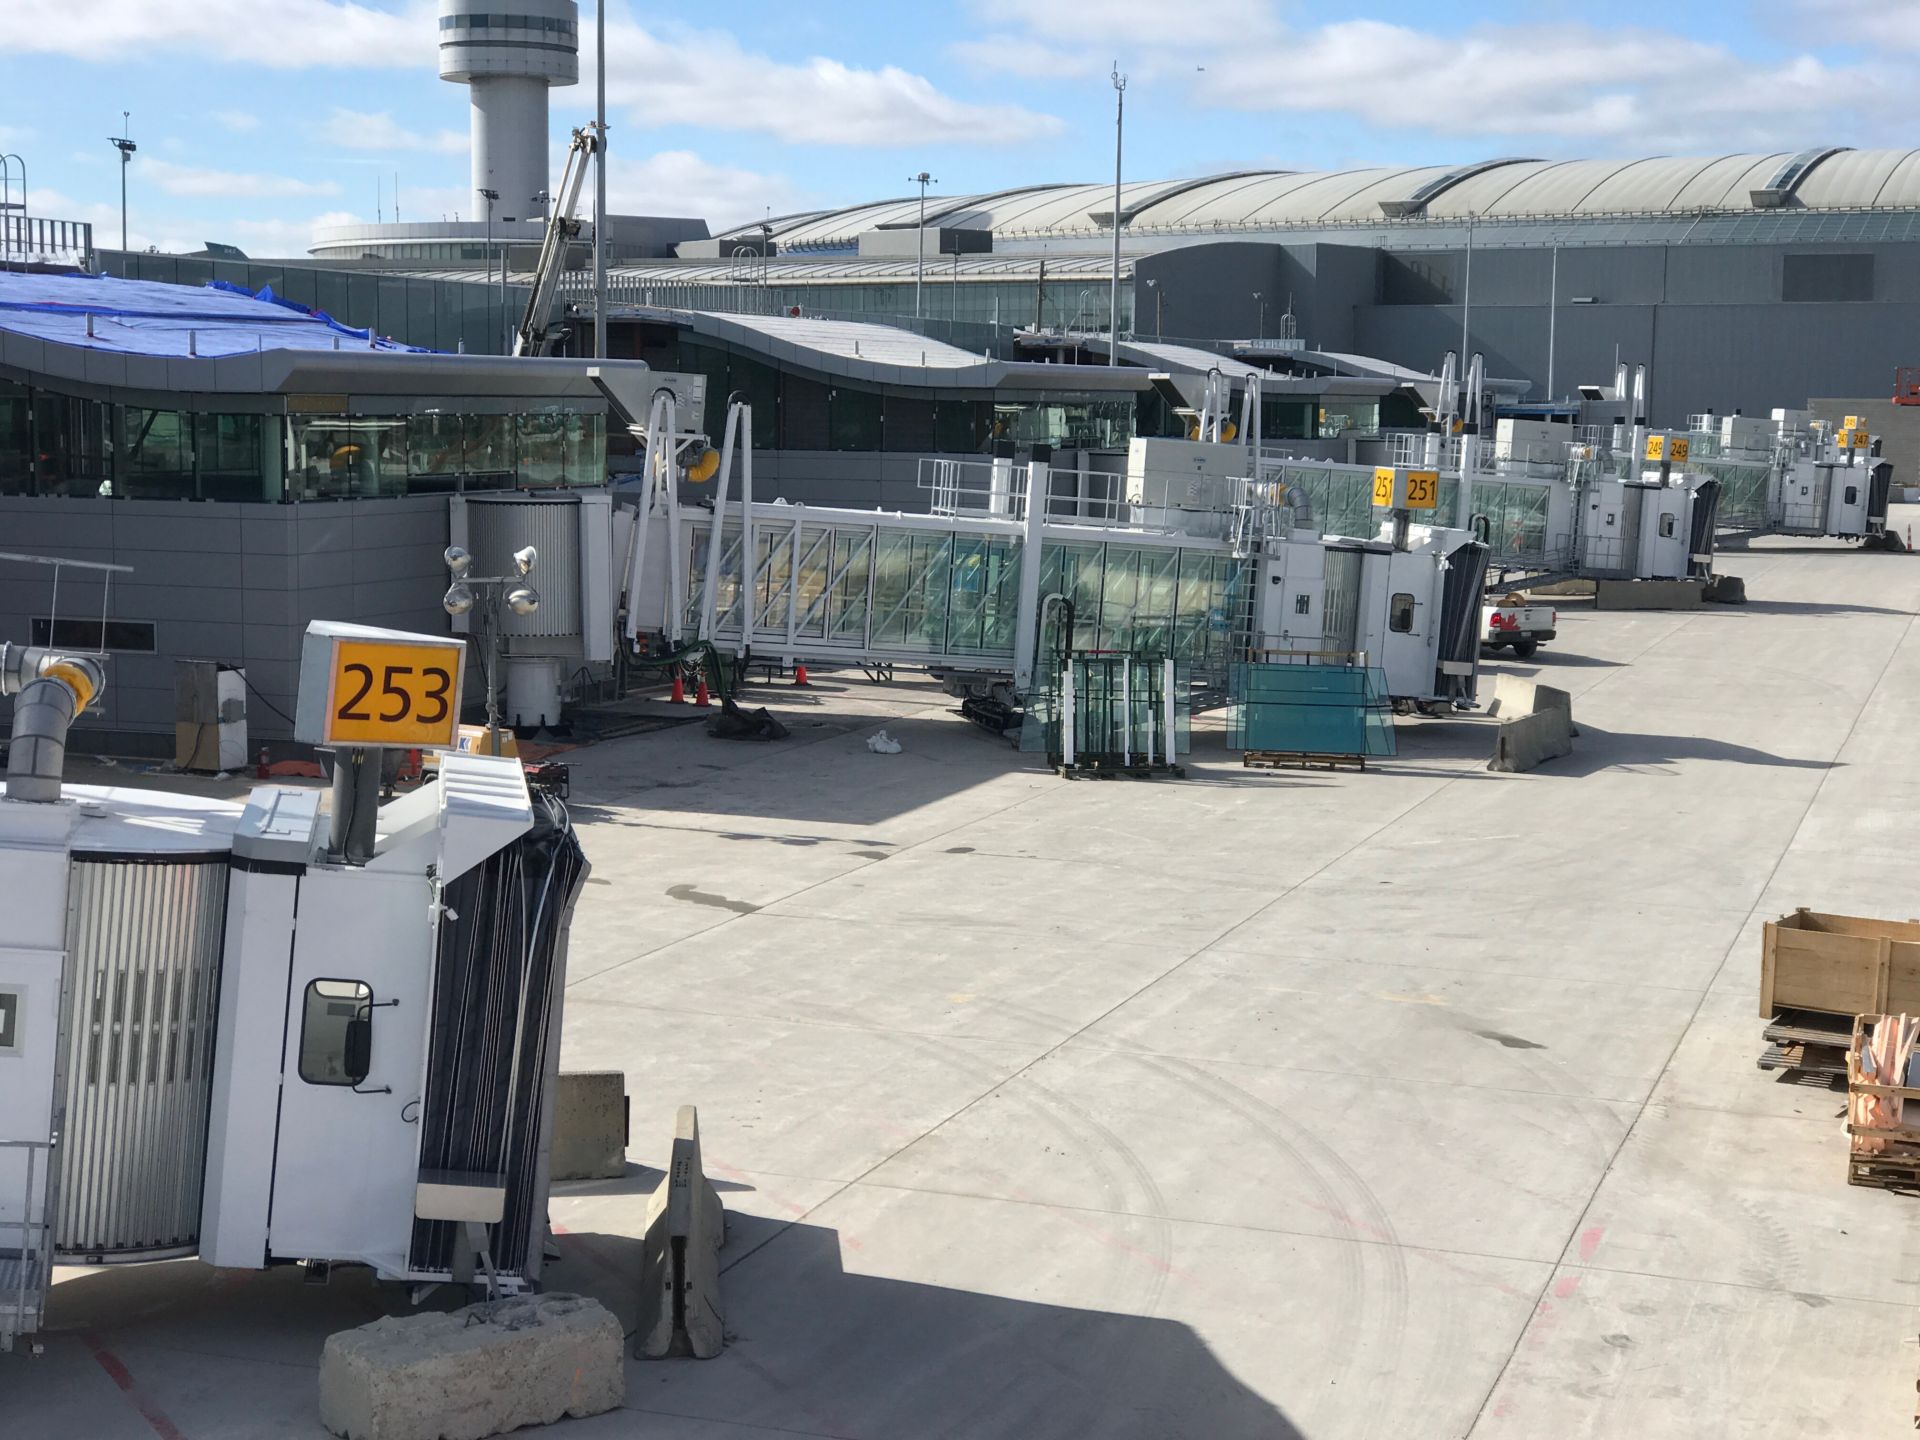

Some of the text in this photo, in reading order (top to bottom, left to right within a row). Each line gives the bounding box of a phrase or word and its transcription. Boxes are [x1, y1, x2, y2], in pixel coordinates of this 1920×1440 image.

[1648, 441, 1662, 455] 249
[1854, 434, 1868, 444] 247
[1671, 443, 1687, 457] 249
[1376, 476, 1393, 498] 251
[1408, 479, 1436, 501] 251
[338, 663, 451, 724] 253
